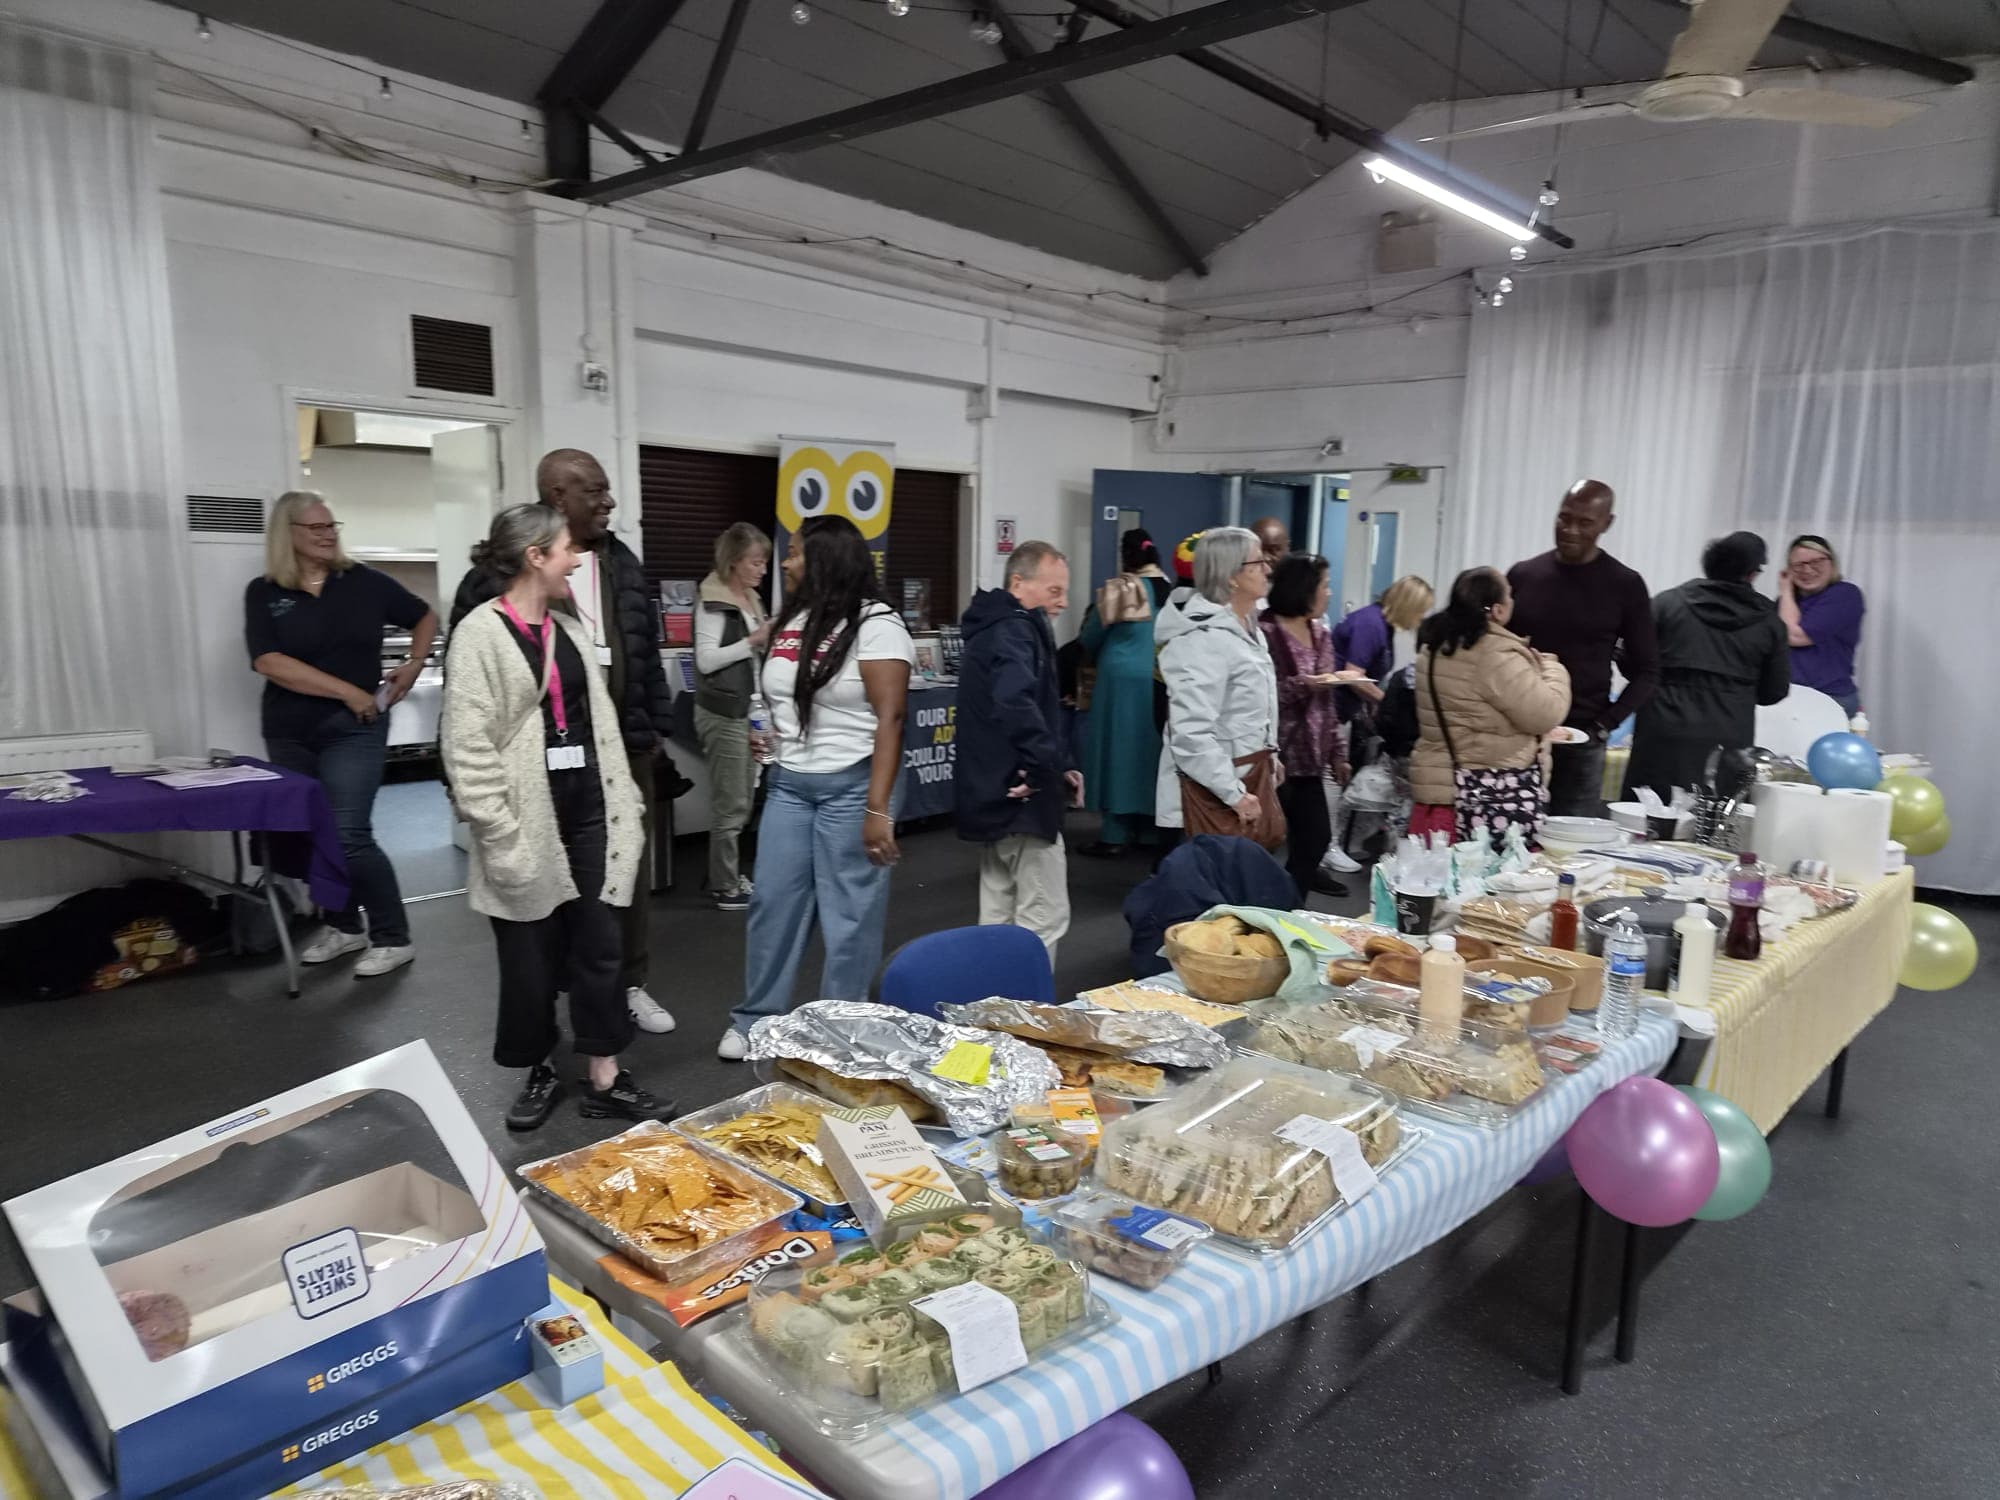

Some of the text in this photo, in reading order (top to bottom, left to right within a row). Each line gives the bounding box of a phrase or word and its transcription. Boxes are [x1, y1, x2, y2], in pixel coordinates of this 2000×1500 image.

[916, 707, 947, 727] OUR
[904, 745, 946, 768] COULD
[916, 763, 953, 785] YOUR
[855, 1145, 925, 1160] BREADSTICKS
[296, 1255, 357, 1290] TREATS
[306, 1271, 356, 1304] SWEET
[325, 1340, 400, 1384] GREGGS
[301, 1408, 380, 1453] GREGGS
